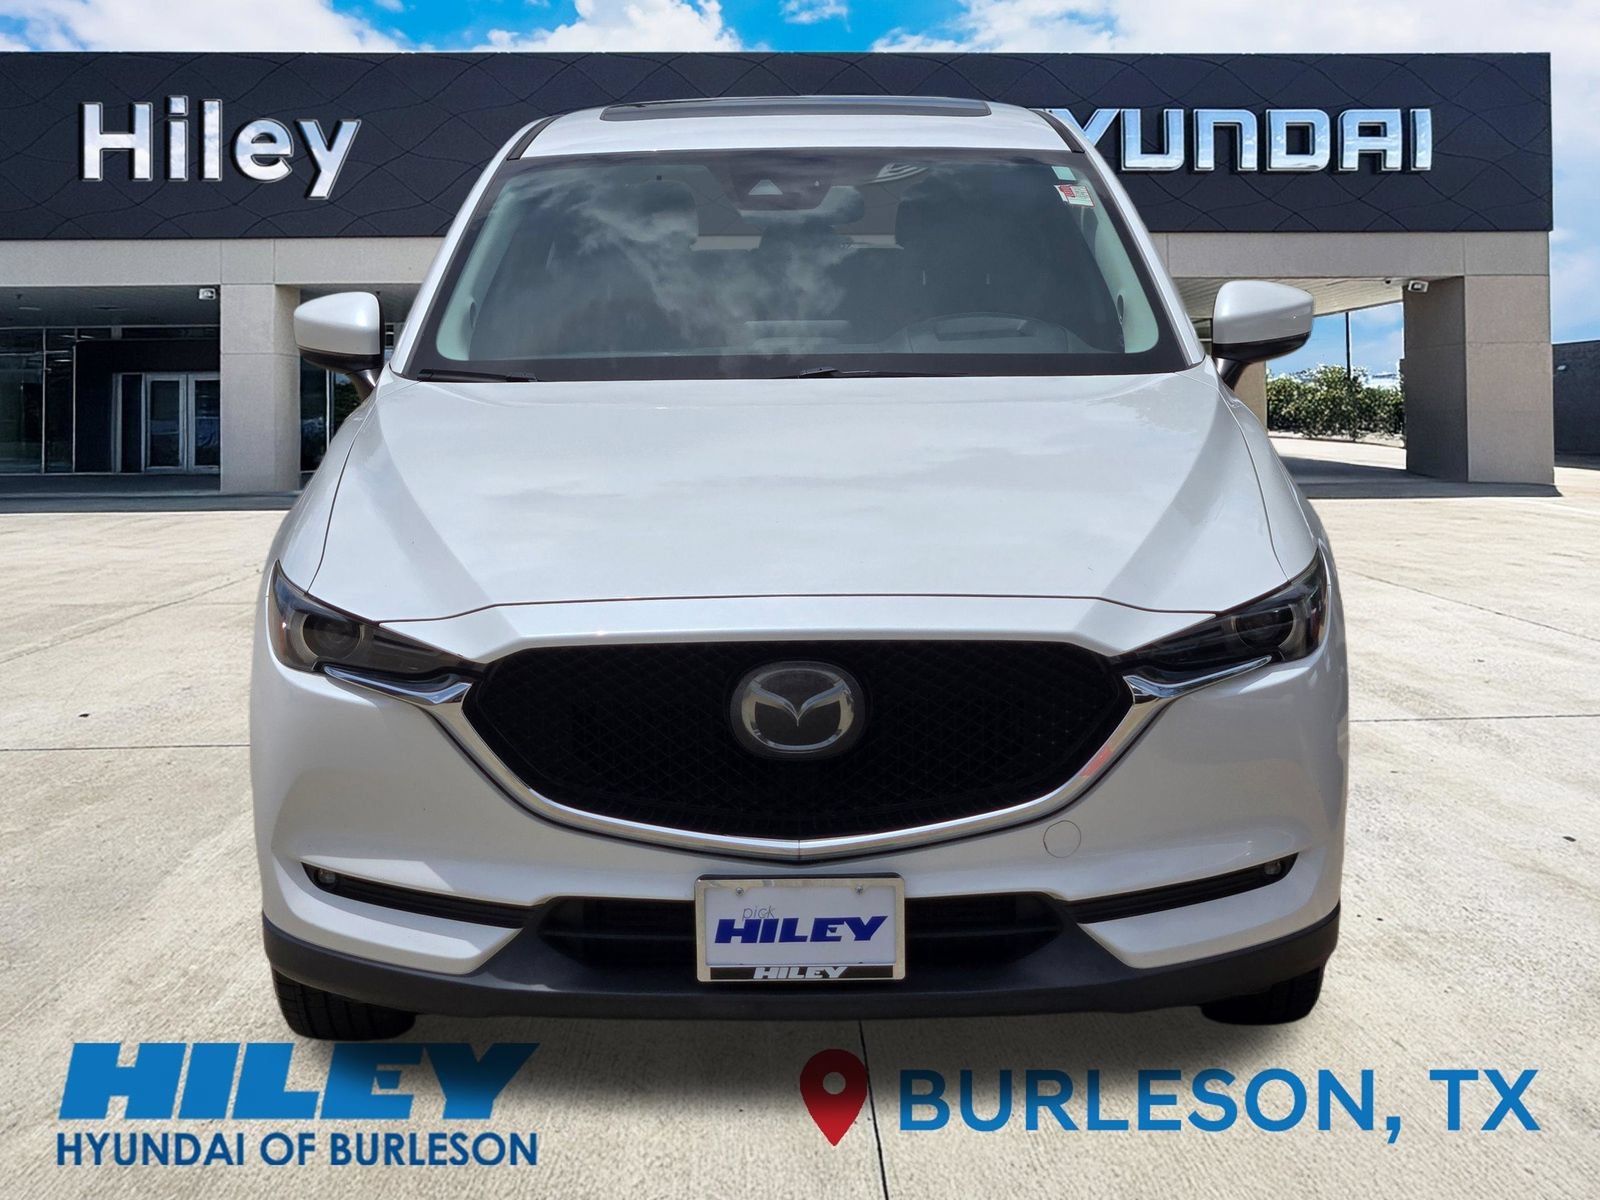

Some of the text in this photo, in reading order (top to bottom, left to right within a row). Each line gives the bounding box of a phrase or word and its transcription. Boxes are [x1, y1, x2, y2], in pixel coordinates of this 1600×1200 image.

[80, 95, 361, 199] Hiley
[1028, 107, 1432, 172] YUNDAI
[714, 915, 888, 943] HILEY
[753, 966, 847, 979] HILEY
